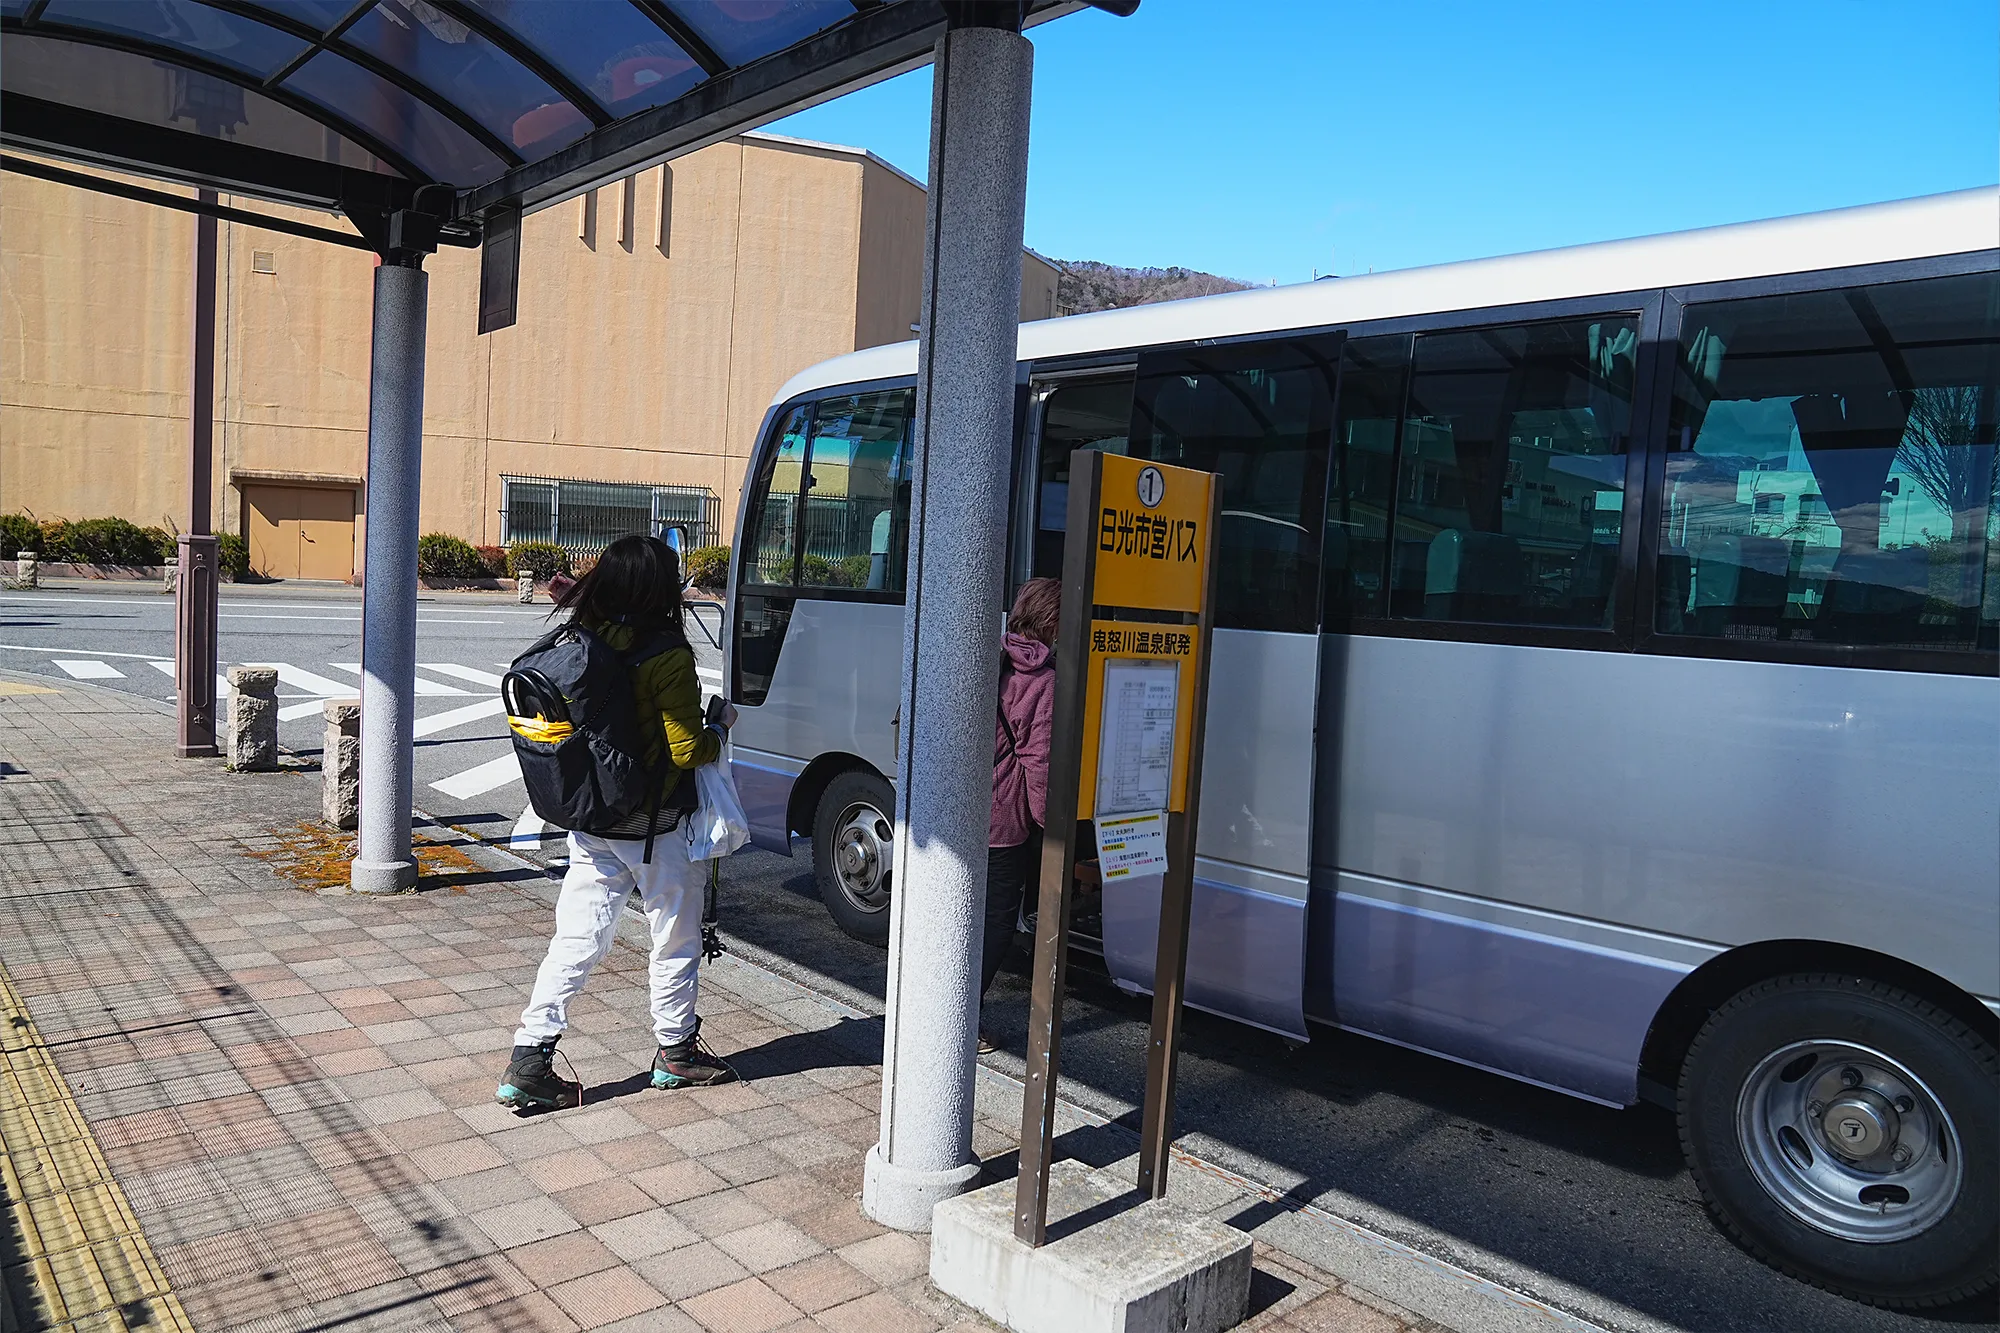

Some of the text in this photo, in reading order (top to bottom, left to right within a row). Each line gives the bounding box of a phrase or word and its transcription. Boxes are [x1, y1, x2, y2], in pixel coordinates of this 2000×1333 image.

[1145, 471, 1154, 502] 1
[1100, 508, 1197, 563] 日光市営バス
[1092, 629, 1191, 656] 鬼怒川温泉駅発
